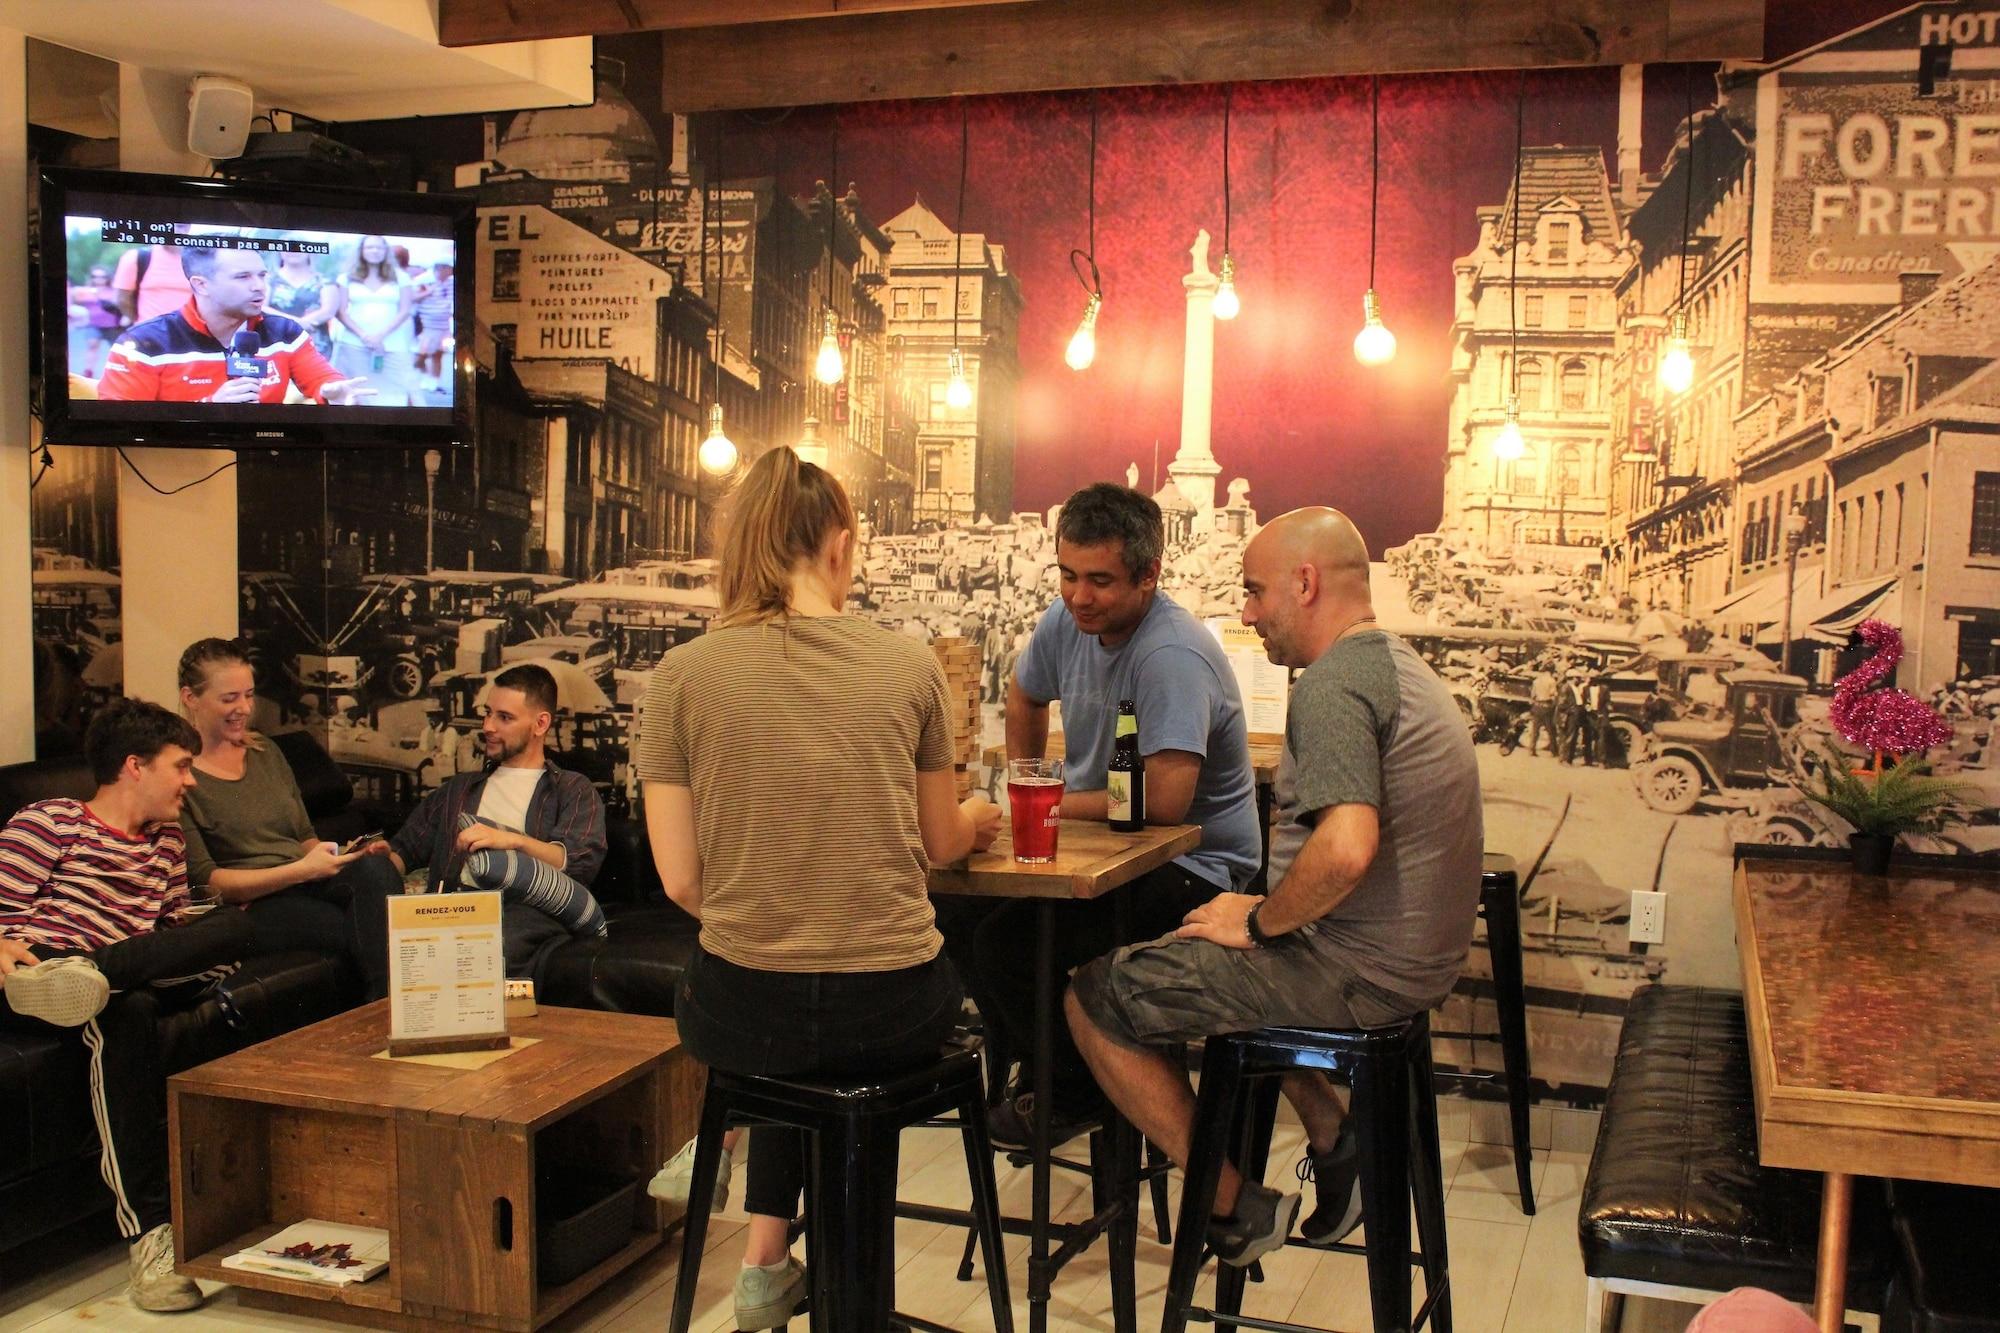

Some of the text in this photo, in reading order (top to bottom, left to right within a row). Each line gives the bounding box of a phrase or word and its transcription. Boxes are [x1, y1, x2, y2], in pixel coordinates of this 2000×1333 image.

[1920, 11, 2000, 46] HOT
[1781, 113, 2000, 179] FORE
[101, 219, 174, 233] qu'il on?
[476, 215, 540, 241] EL
[117, 232, 134, 244] Je
[143, 234, 166, 245] les
[174, 237, 229, 249] connais
[237, 241, 260, 252] pas
[268, 242, 291, 252] mal
[299, 243, 328, 254] tous
[1808, 247, 1932, 273] Canadien
[540, 267, 604, 277] PEINTURES
[540, 327, 613, 350] HUILE
[415, 905, 476, 915] RENDEZ-VOUS
